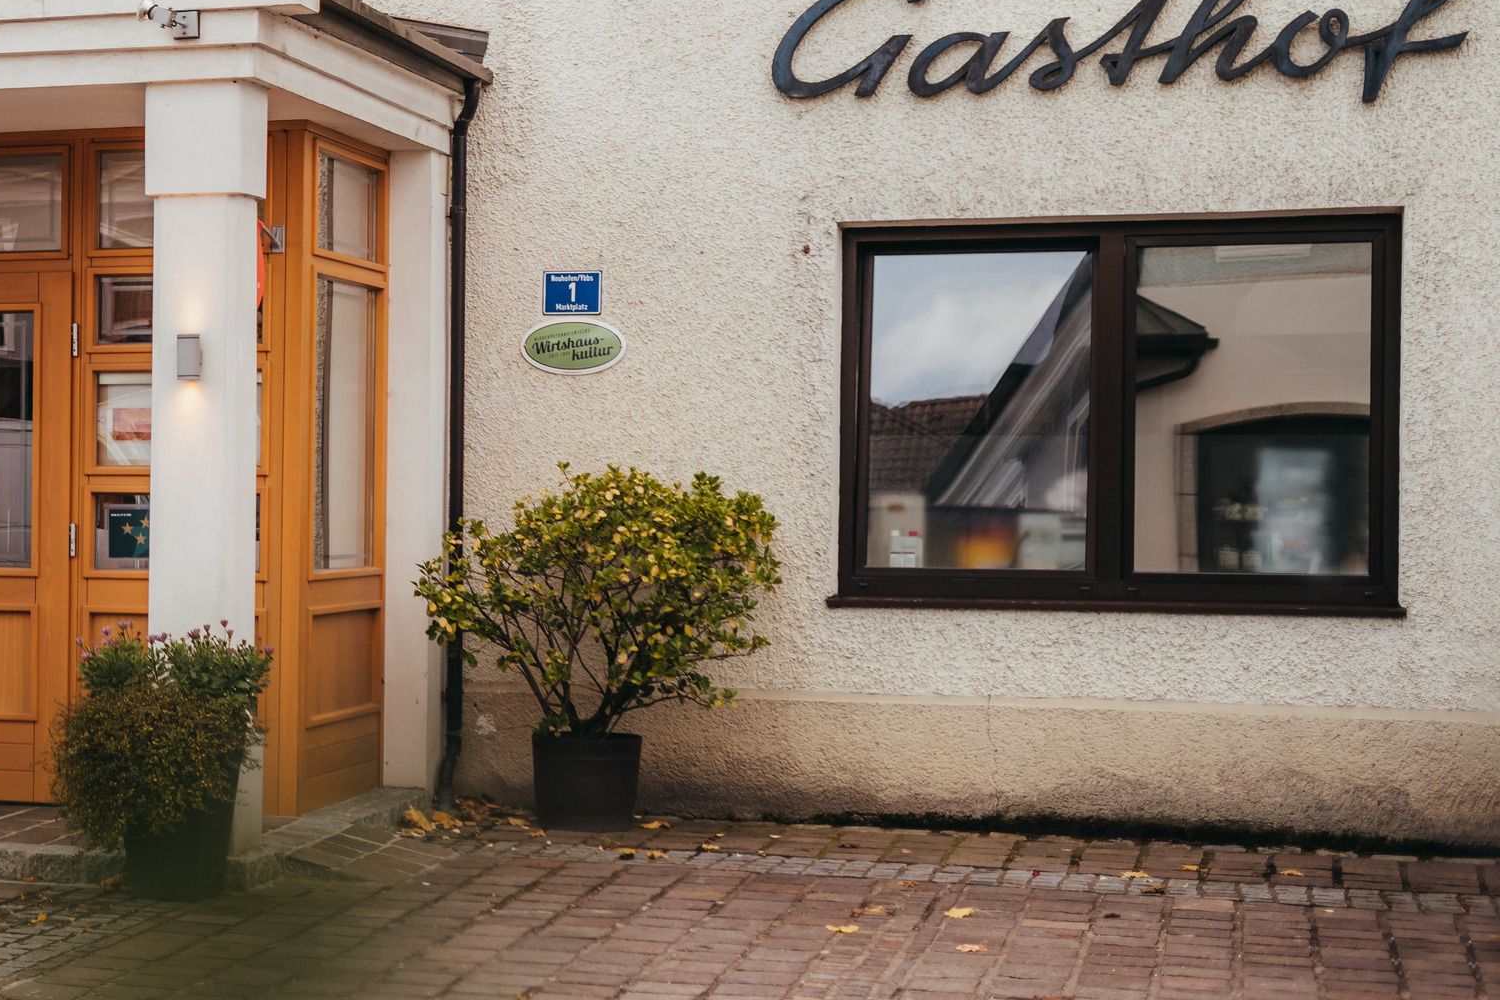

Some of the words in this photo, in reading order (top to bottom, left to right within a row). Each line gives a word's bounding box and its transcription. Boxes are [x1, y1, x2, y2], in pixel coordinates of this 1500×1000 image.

[568, 282, 576, 303] 1
[555, 303, 589, 312] Marktplatz
[532, 337, 604, 355] Wirtshaus-
[571, 345, 614, 361] kultur
